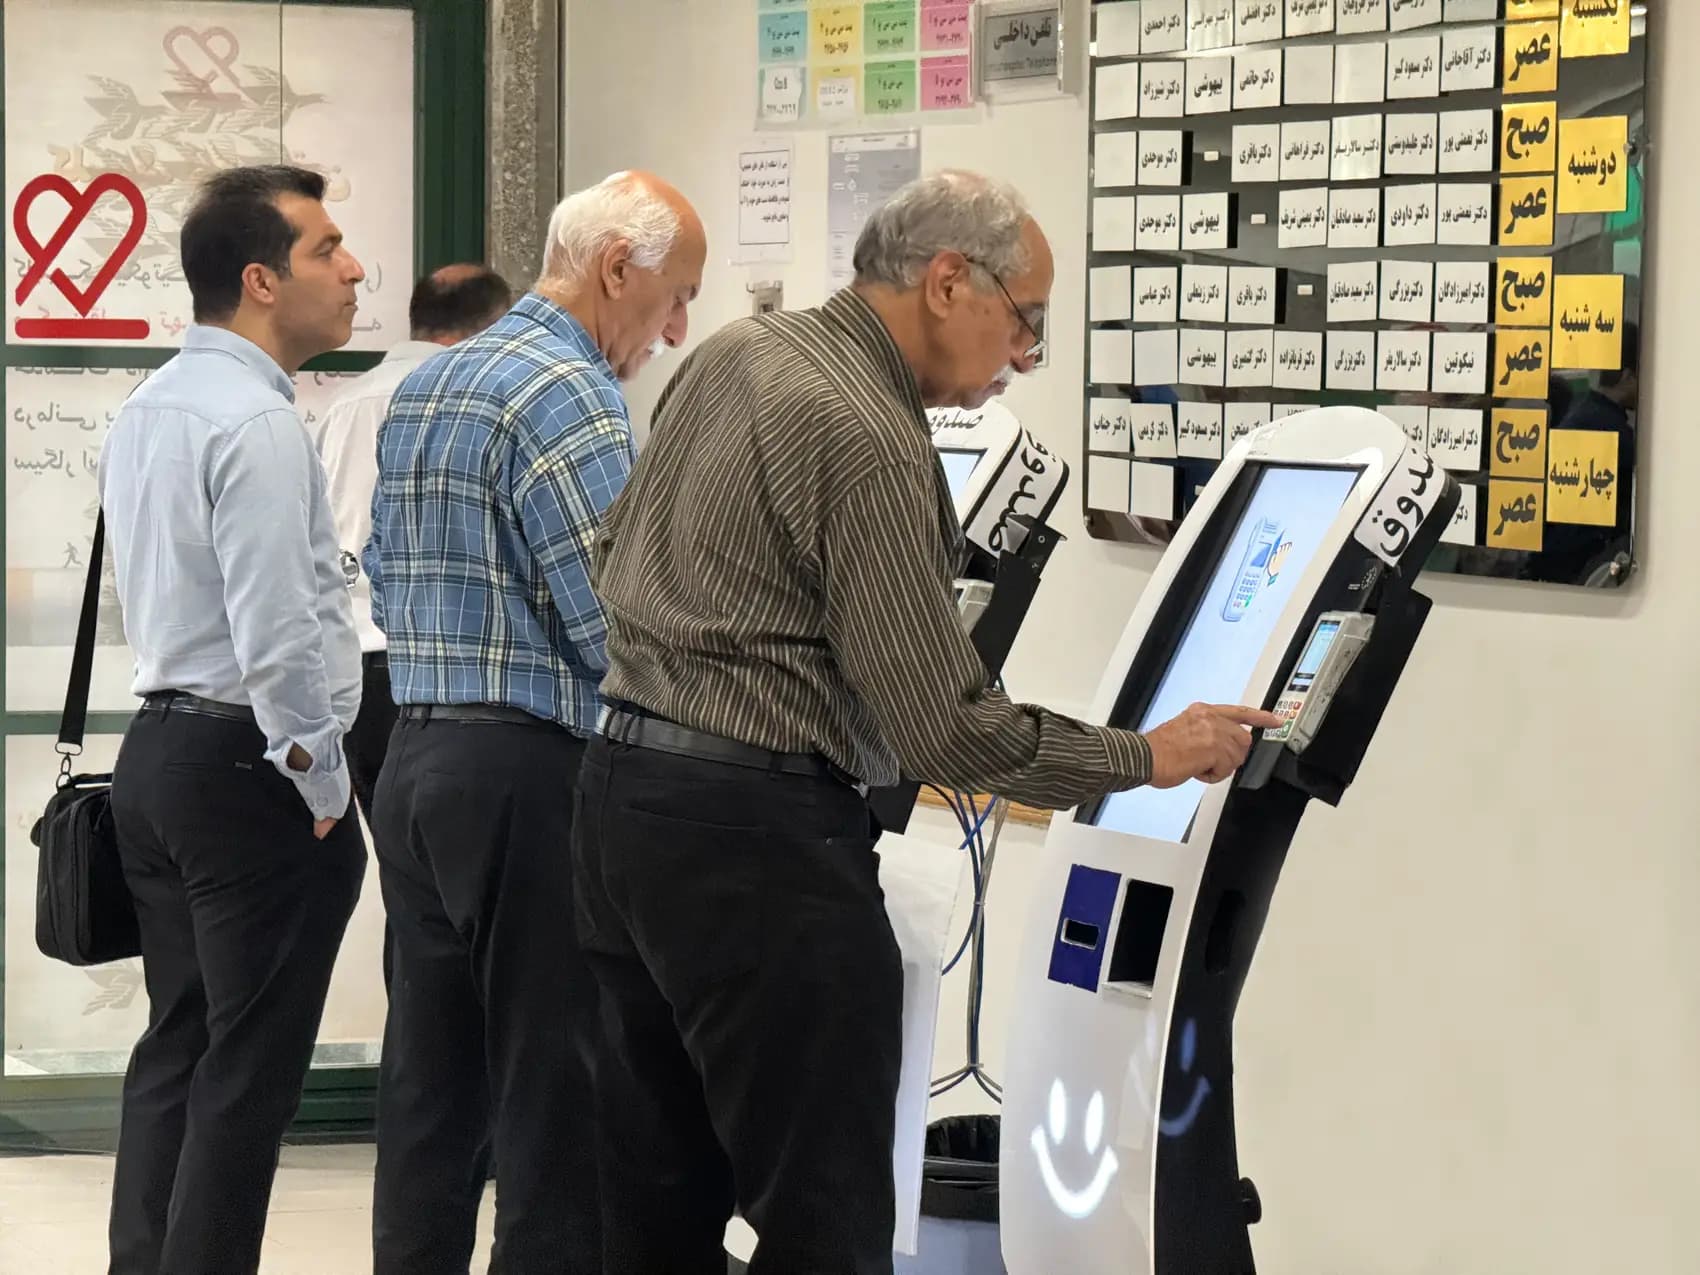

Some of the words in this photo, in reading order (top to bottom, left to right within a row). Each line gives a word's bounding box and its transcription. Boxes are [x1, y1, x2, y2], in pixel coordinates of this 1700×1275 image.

[1475, 47, 1491, 70] دکتر
[1508, 32, 1551, 82] عصر
[1165, 79, 1180, 100] دکتر
[1260, 68, 1275, 90] دکتر
[1418, 133, 1433, 155] دکتر
[1474, 129, 1488, 152] دکتر
[1506, 116, 1550, 160] صبح
[1164, 147, 1178, 169] دکتر
[1258, 143, 1272, 165] دکتر
[1309, 141, 1325, 161] دکتر
[1414, 203, 1430, 226] دکتر
[1472, 205, 1488, 224] دکتر
[1504, 187, 1547, 234] عصر
[1162, 212, 1176, 234] دکتر
[1157, 284, 1171, 306] دکتر
[1206, 283, 1220, 304] دکتر
[1253, 285, 1267, 306] دکتر
[1409, 280, 1424, 302] دکتر
[1470, 279, 1485, 304] دکتر
[1501, 266, 1546, 312] صبح
[1559, 303, 1591, 342] شنبه
[1594, 309, 1615, 334] سه
[1253, 348, 1267, 370] دکتر
[1302, 350, 1315, 371] دکتر
[1352, 350, 1366, 372] دکتر
[1408, 350, 1422, 372] دکتر
[1499, 341, 1543, 386] عصر
[1112, 415, 1127, 436] دکتر
[1157, 420, 1169, 441] دکتر
[1464, 426, 1478, 451] دکتر
[1496, 418, 1541, 464] صبح
[1494, 493, 1537, 536] عصر
